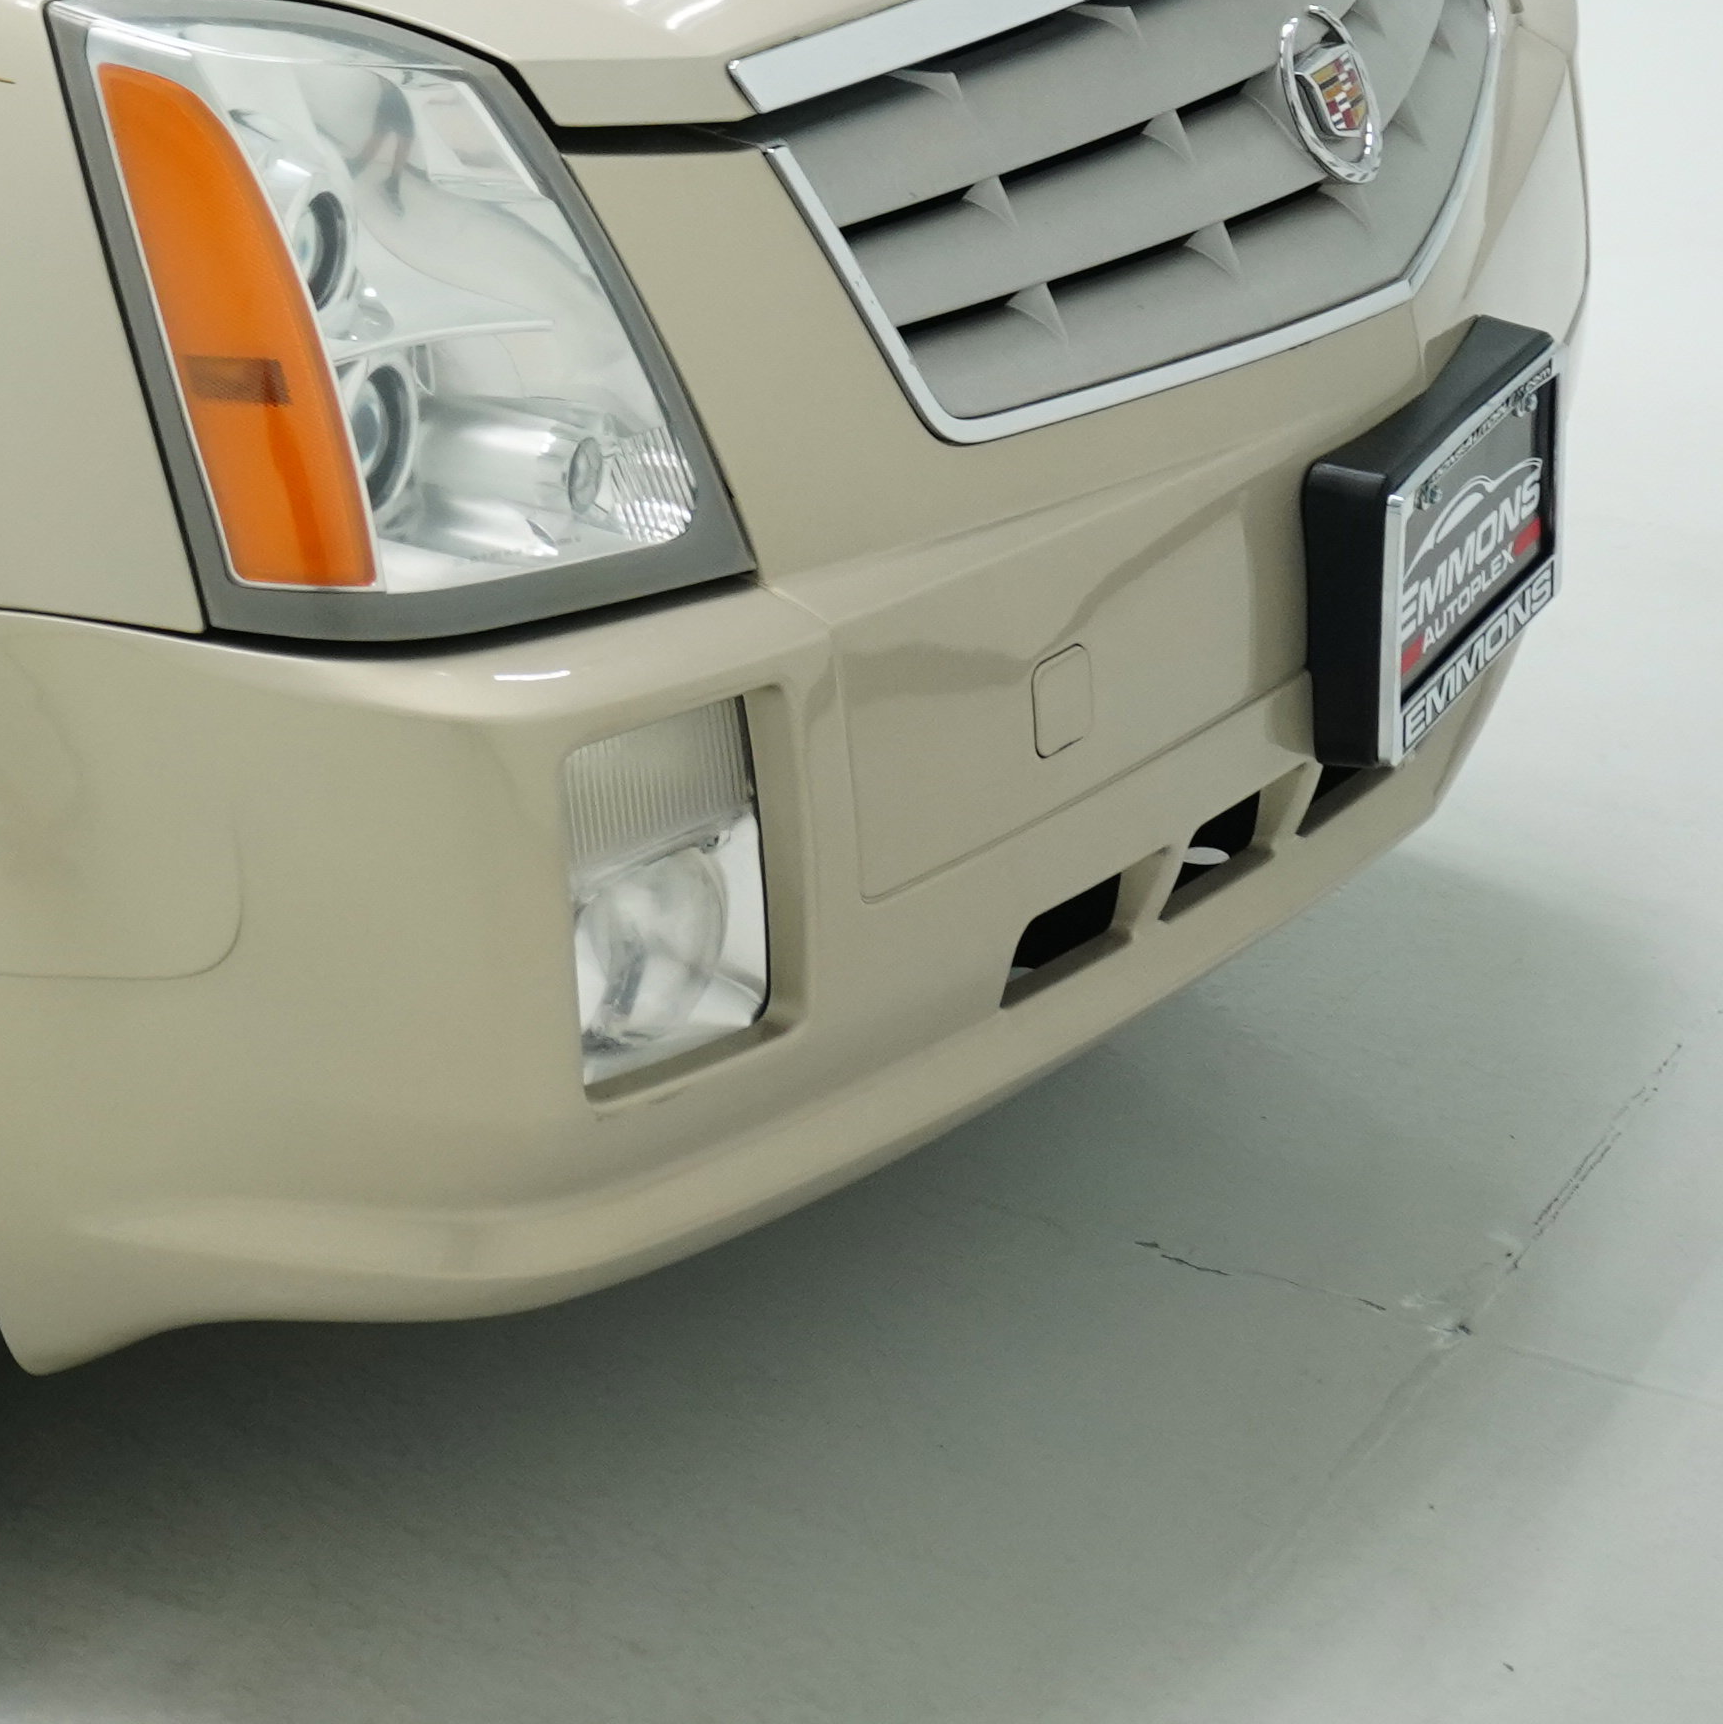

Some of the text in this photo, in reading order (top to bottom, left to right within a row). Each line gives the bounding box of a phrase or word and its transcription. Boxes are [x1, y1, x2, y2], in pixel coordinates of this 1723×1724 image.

[1401, 469, 1541, 643] EMMONS
[1423, 541, 1515, 654] AUTOPLEX
[1405, 567, 1553, 749] EMMONS
